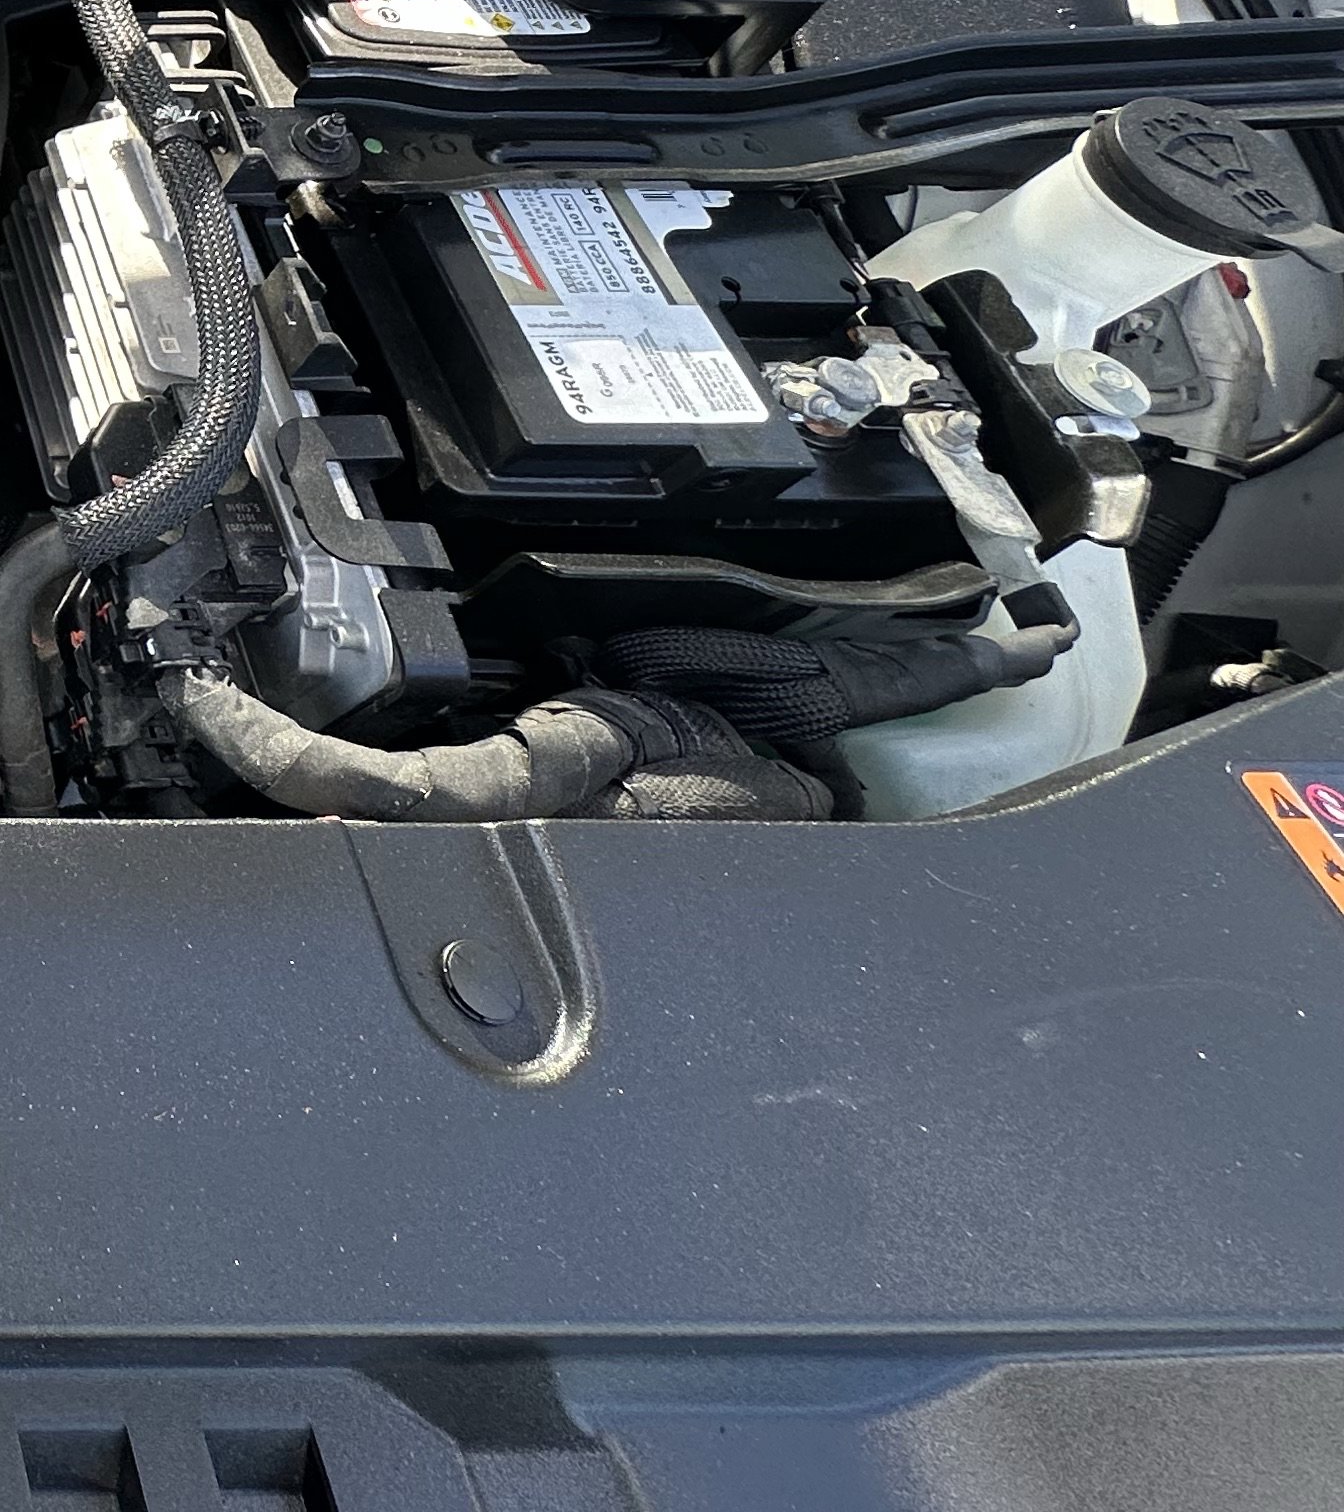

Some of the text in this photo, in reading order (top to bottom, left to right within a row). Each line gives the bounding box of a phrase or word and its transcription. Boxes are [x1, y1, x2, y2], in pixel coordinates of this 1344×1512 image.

[569, 213, 587, 231] 140
[588, 244, 621, 288] 850 CCA
[539, 340, 593, 415] 94RAGM
